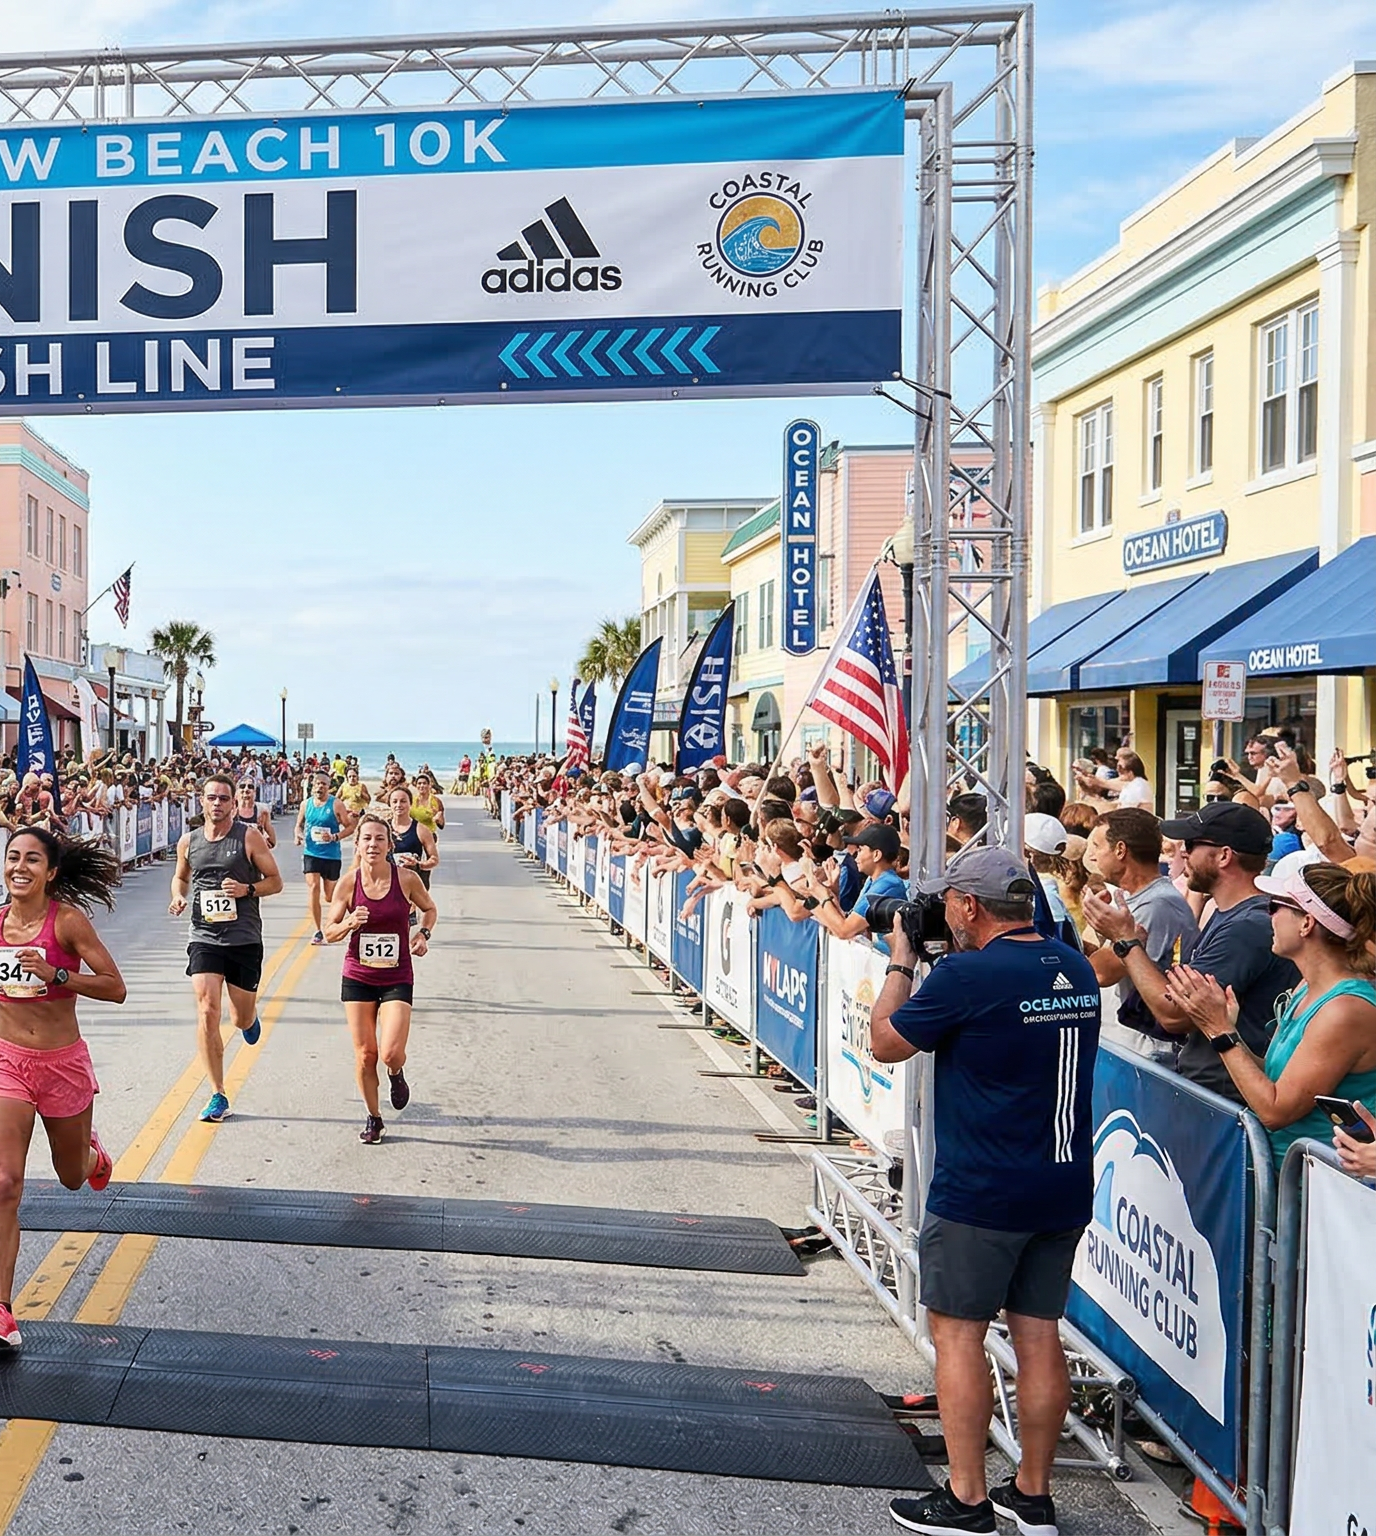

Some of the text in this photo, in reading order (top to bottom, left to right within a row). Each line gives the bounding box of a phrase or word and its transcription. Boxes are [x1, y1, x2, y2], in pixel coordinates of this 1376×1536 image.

[96, 125, 341, 178] BEACH
[374, 117, 508, 168] 10K
[709, 171, 812, 210] COASTAL
[481, 258, 623, 295] adidas
[696, 239, 824, 298] RUNNING CLUB
[97, 336, 276, 394] LINE
[791, 429, 812, 647] OCEAN HOTEL
[1124, 519, 1220, 567] OCEAN HOTEL
[1248, 643, 1323, 671] OCEAN HOTEL
[206, 899, 232, 912] 512
[365, 943, 394, 957] 512
[1116, 1196, 1198, 1306] COASTAL
[1087, 1229, 1198, 1360] RUNNING CLUB
